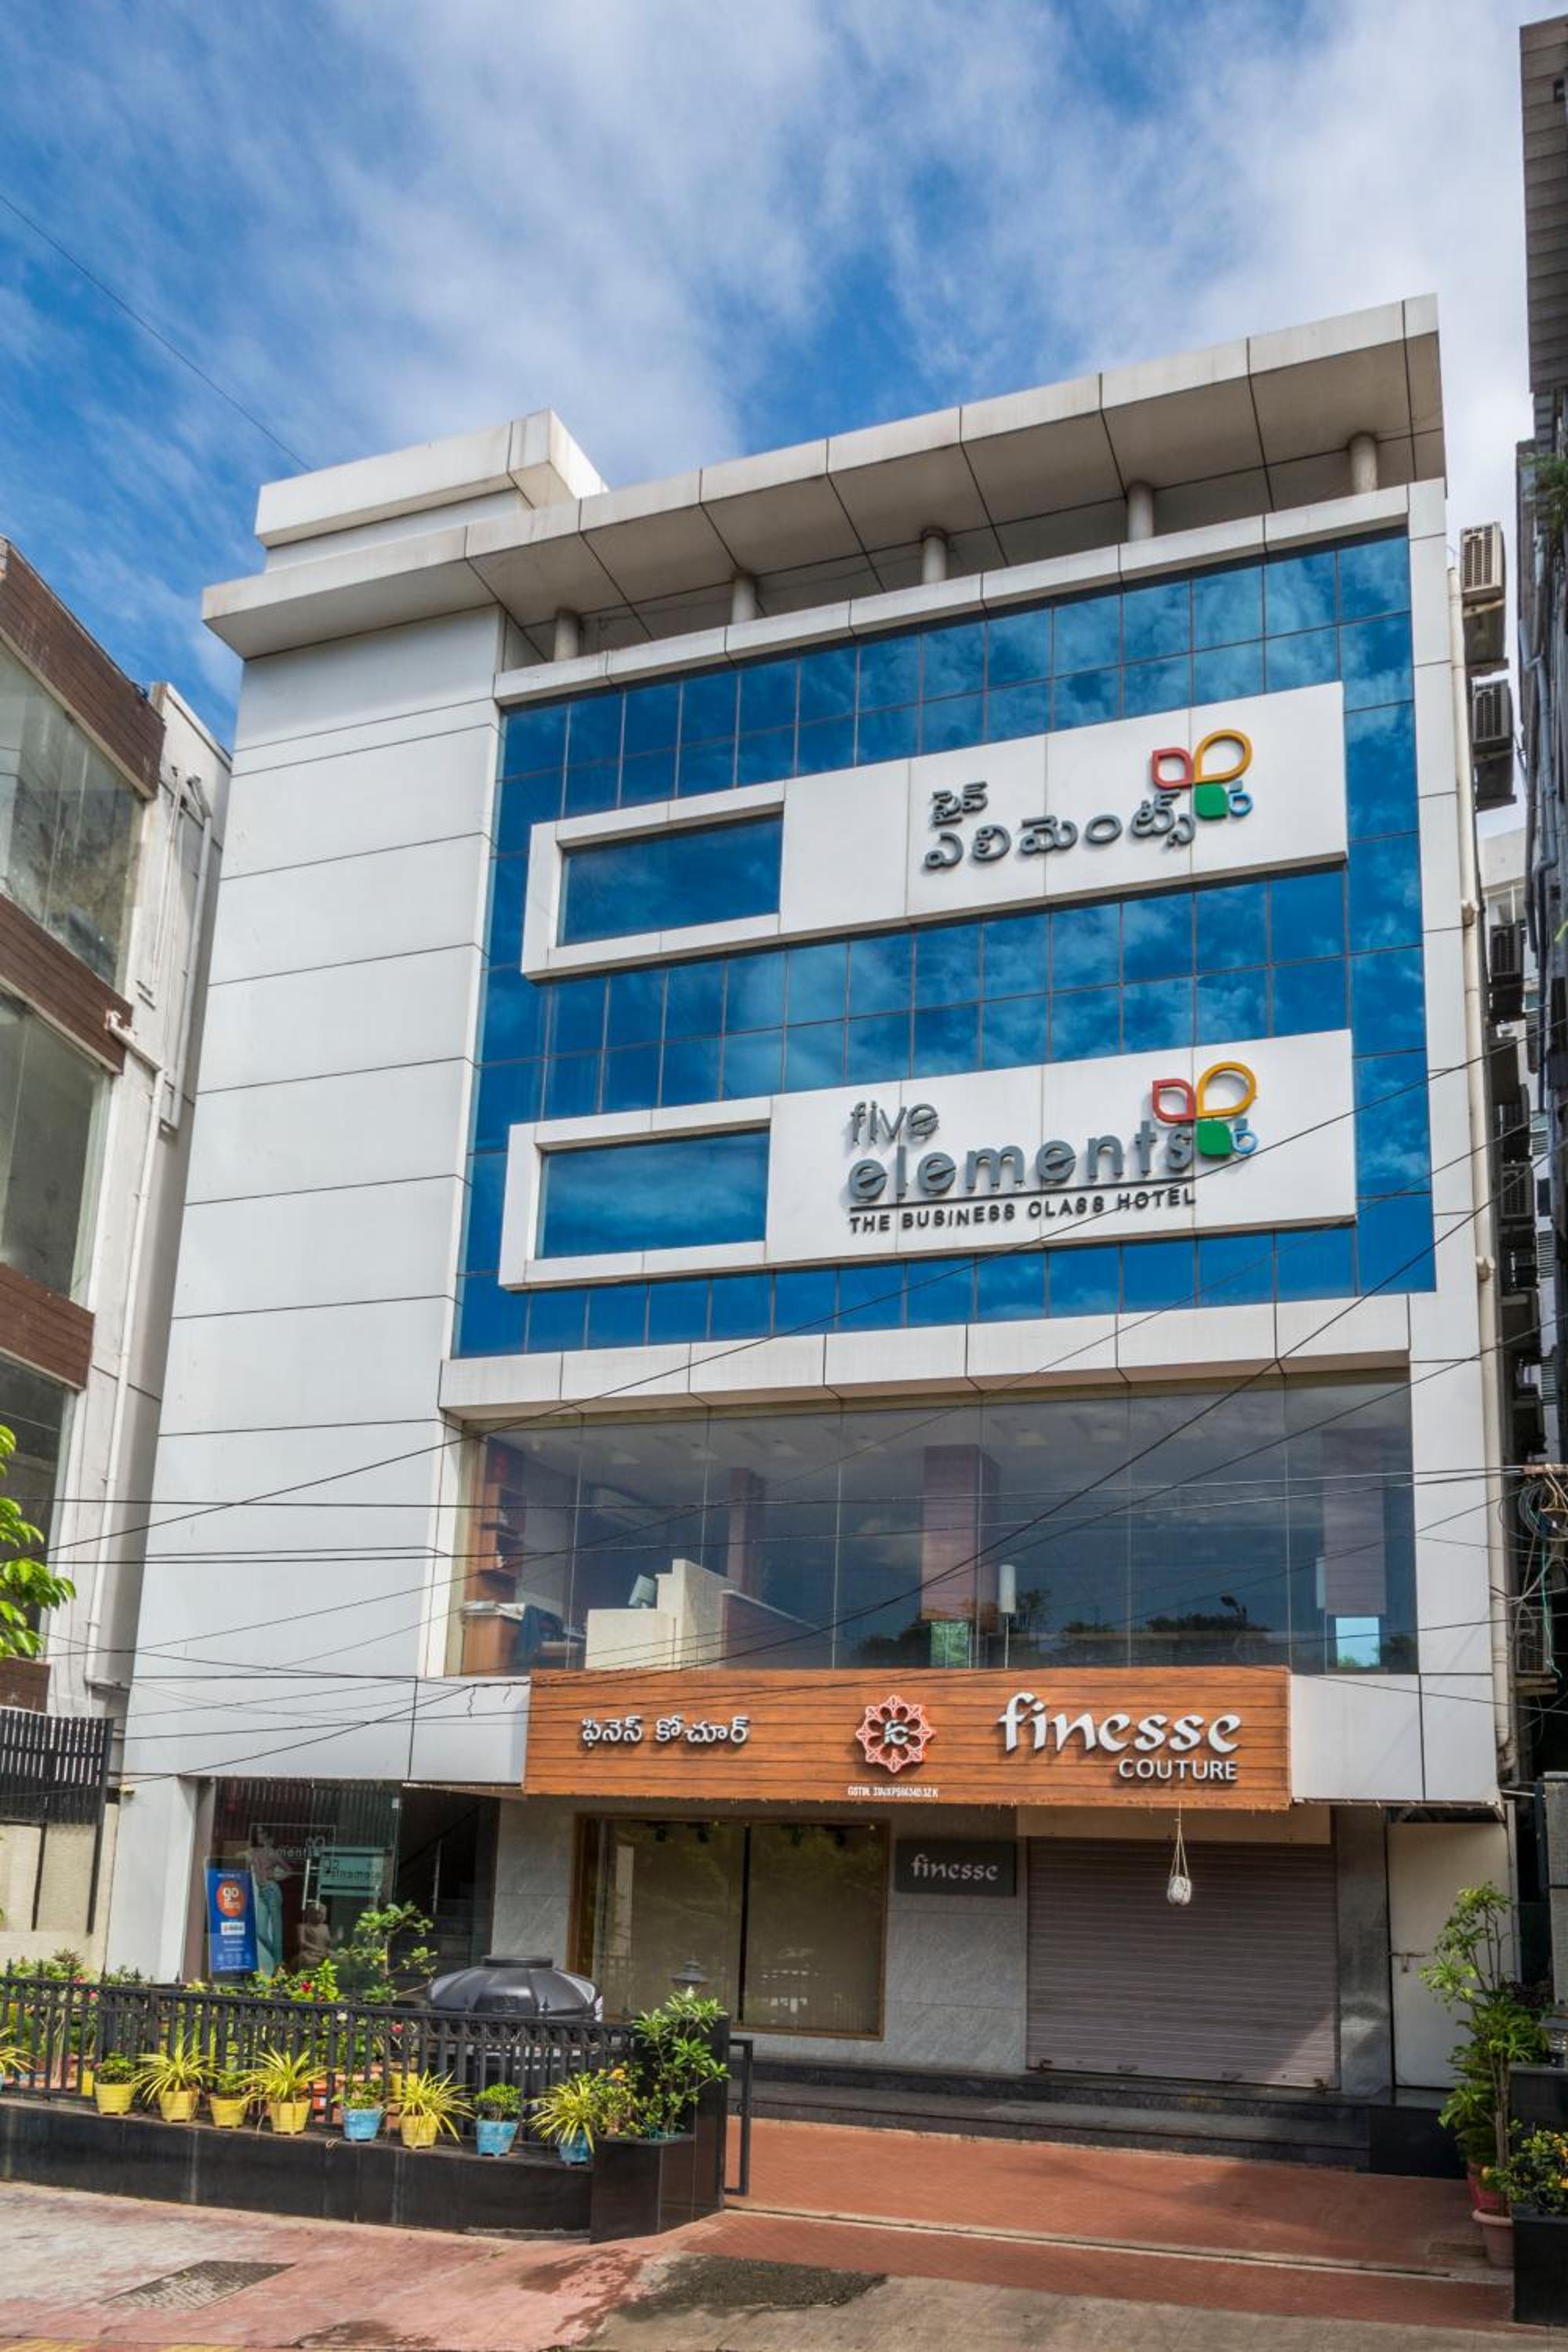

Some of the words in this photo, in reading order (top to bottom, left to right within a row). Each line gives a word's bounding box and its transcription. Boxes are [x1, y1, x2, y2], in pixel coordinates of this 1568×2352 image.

[851, 1100, 939, 1146] five
[848, 1120, 1193, 1201] elements
[849, 1214, 891, 1234] THE
[902, 1203, 1015, 1229] BUSINESS
[1028, 1196, 1105, 1218] CLASS
[1117, 1187, 1196, 1210] HOTEL
[997, 1692, 1242, 1753] finesse
[1119, 1759, 1238, 1781] COUTURE
[911, 1853, 999, 1880] finesse
